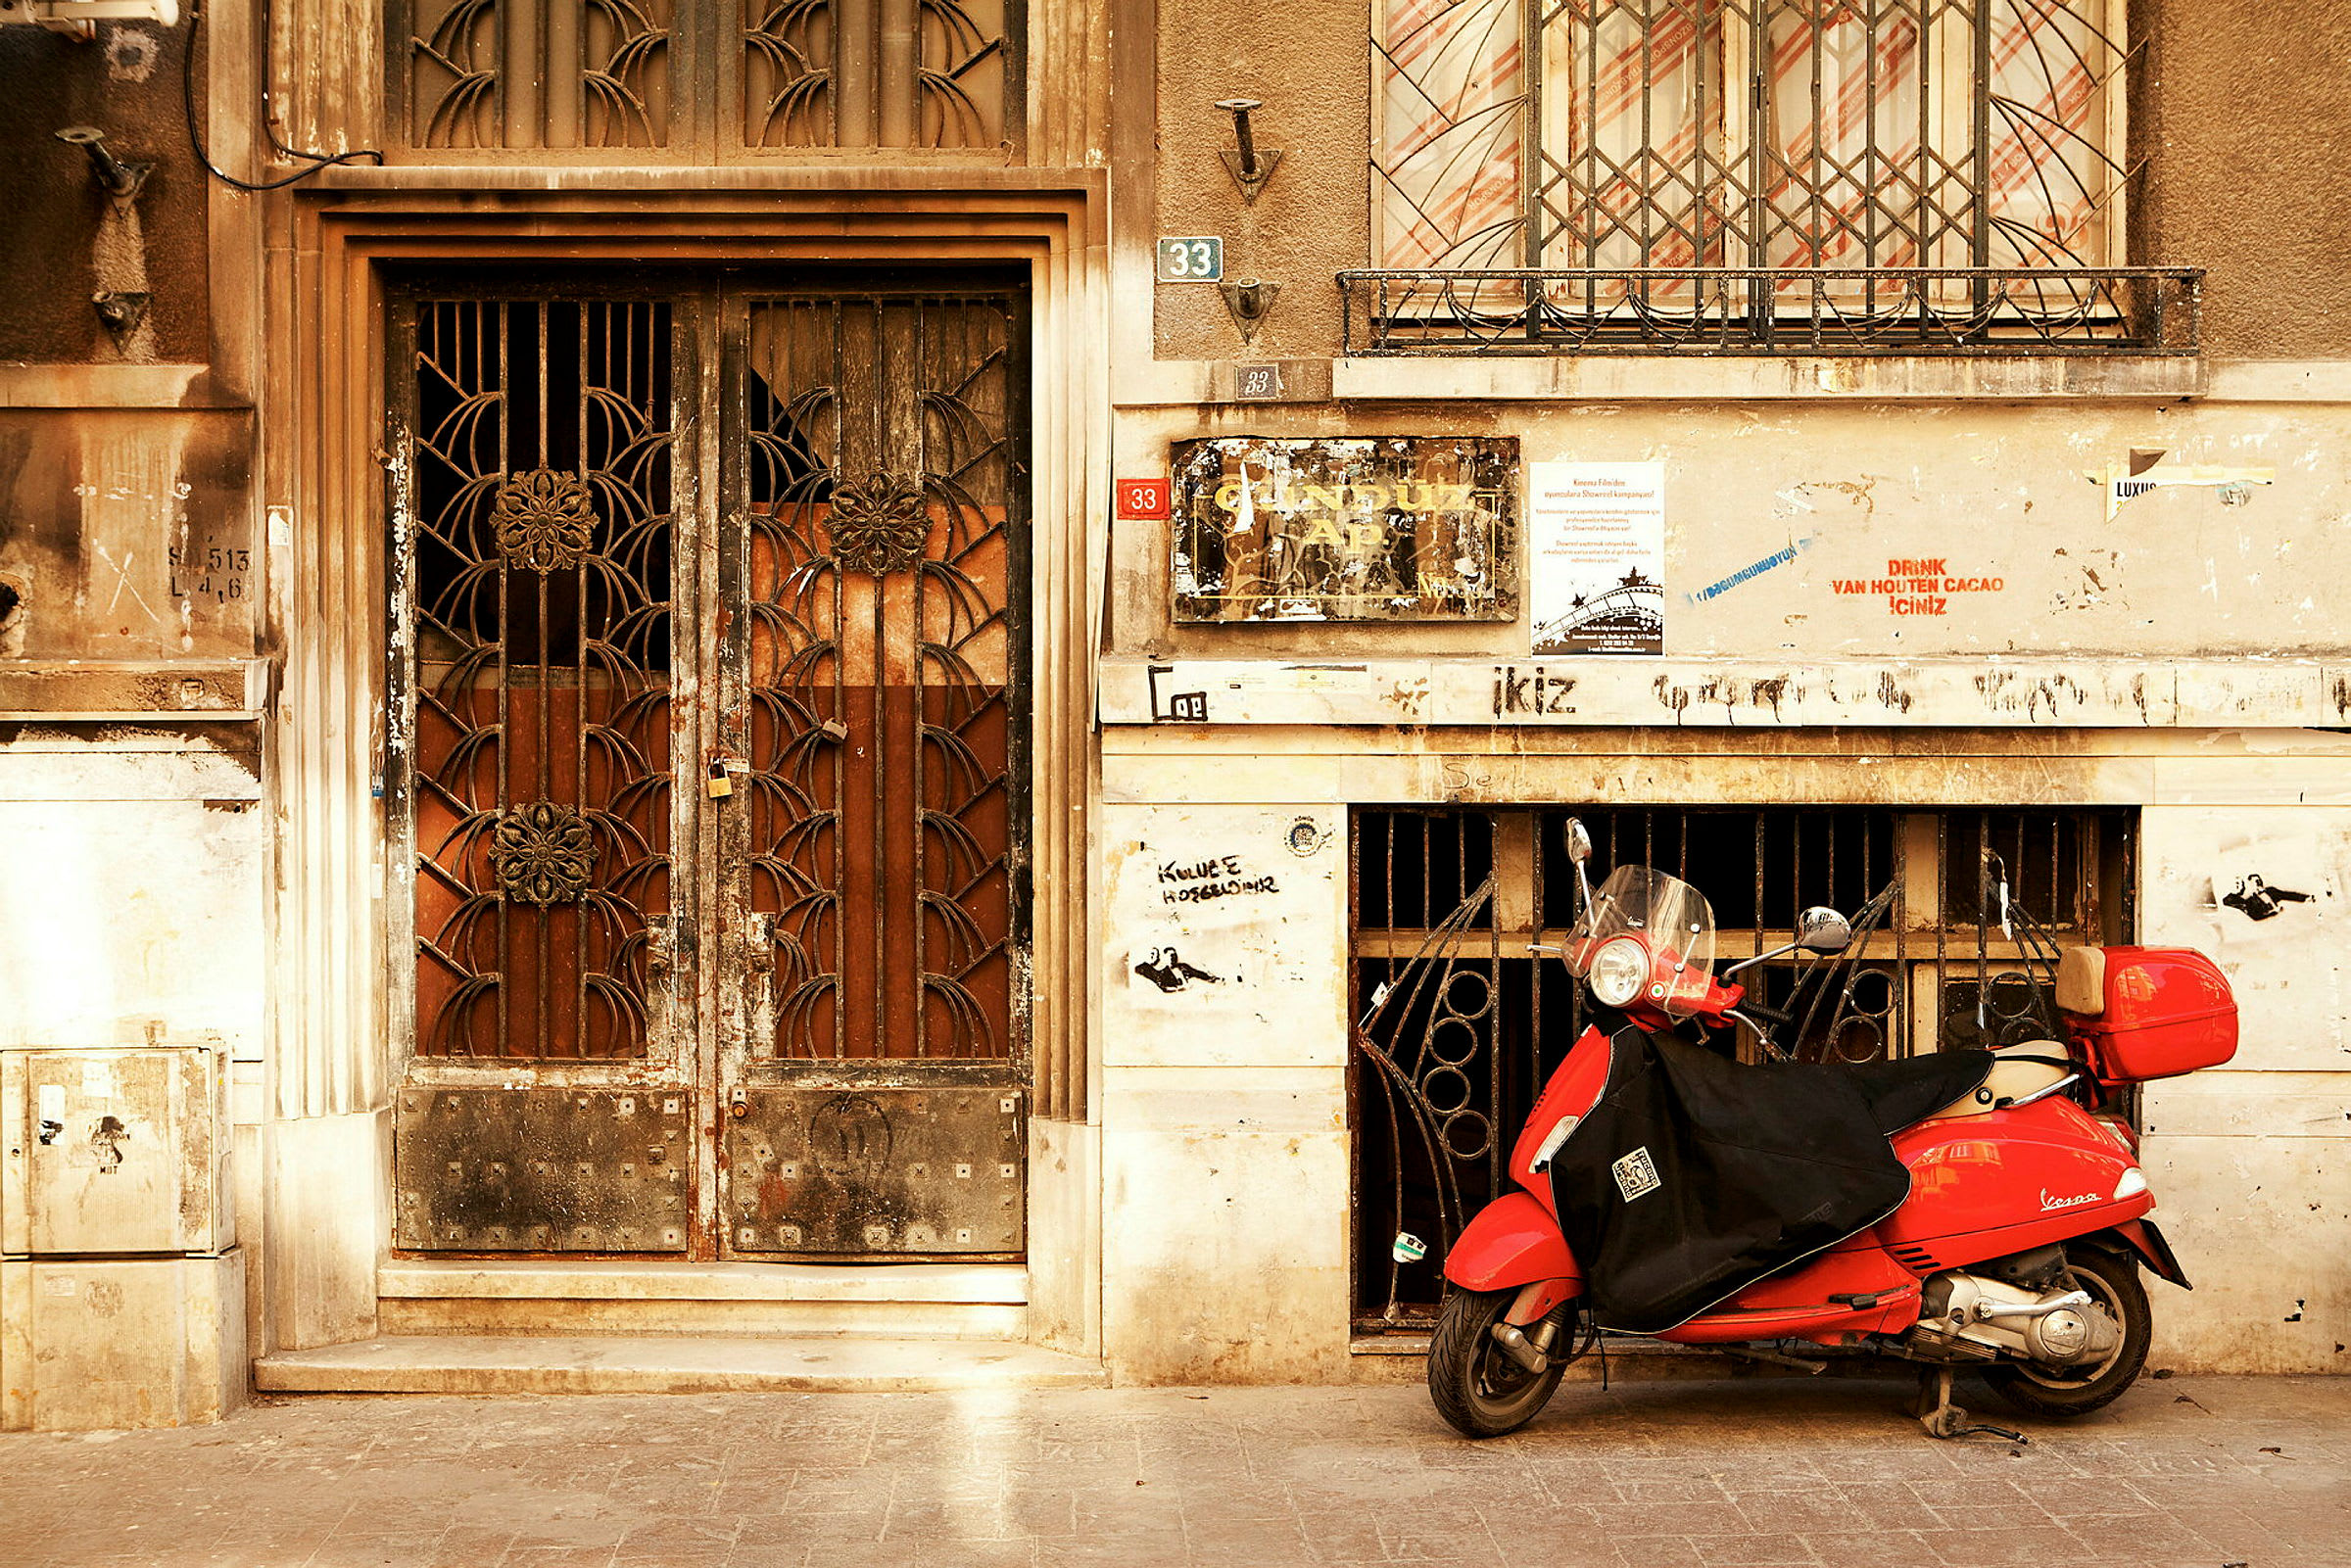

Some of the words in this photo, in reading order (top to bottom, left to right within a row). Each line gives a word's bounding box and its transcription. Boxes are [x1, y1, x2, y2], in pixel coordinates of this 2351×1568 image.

[1169, 242, 1212, 276] 33
[1245, 371, 1269, 394] 33
[1131, 489, 1156, 509] 33
[1833, 580, 1866, 594] VAN
[1871, 579, 1939, 594] HOUTEN
[1943, 578, 2004, 593] CACAO
[2039, 1187, 2103, 1212] Vespa
